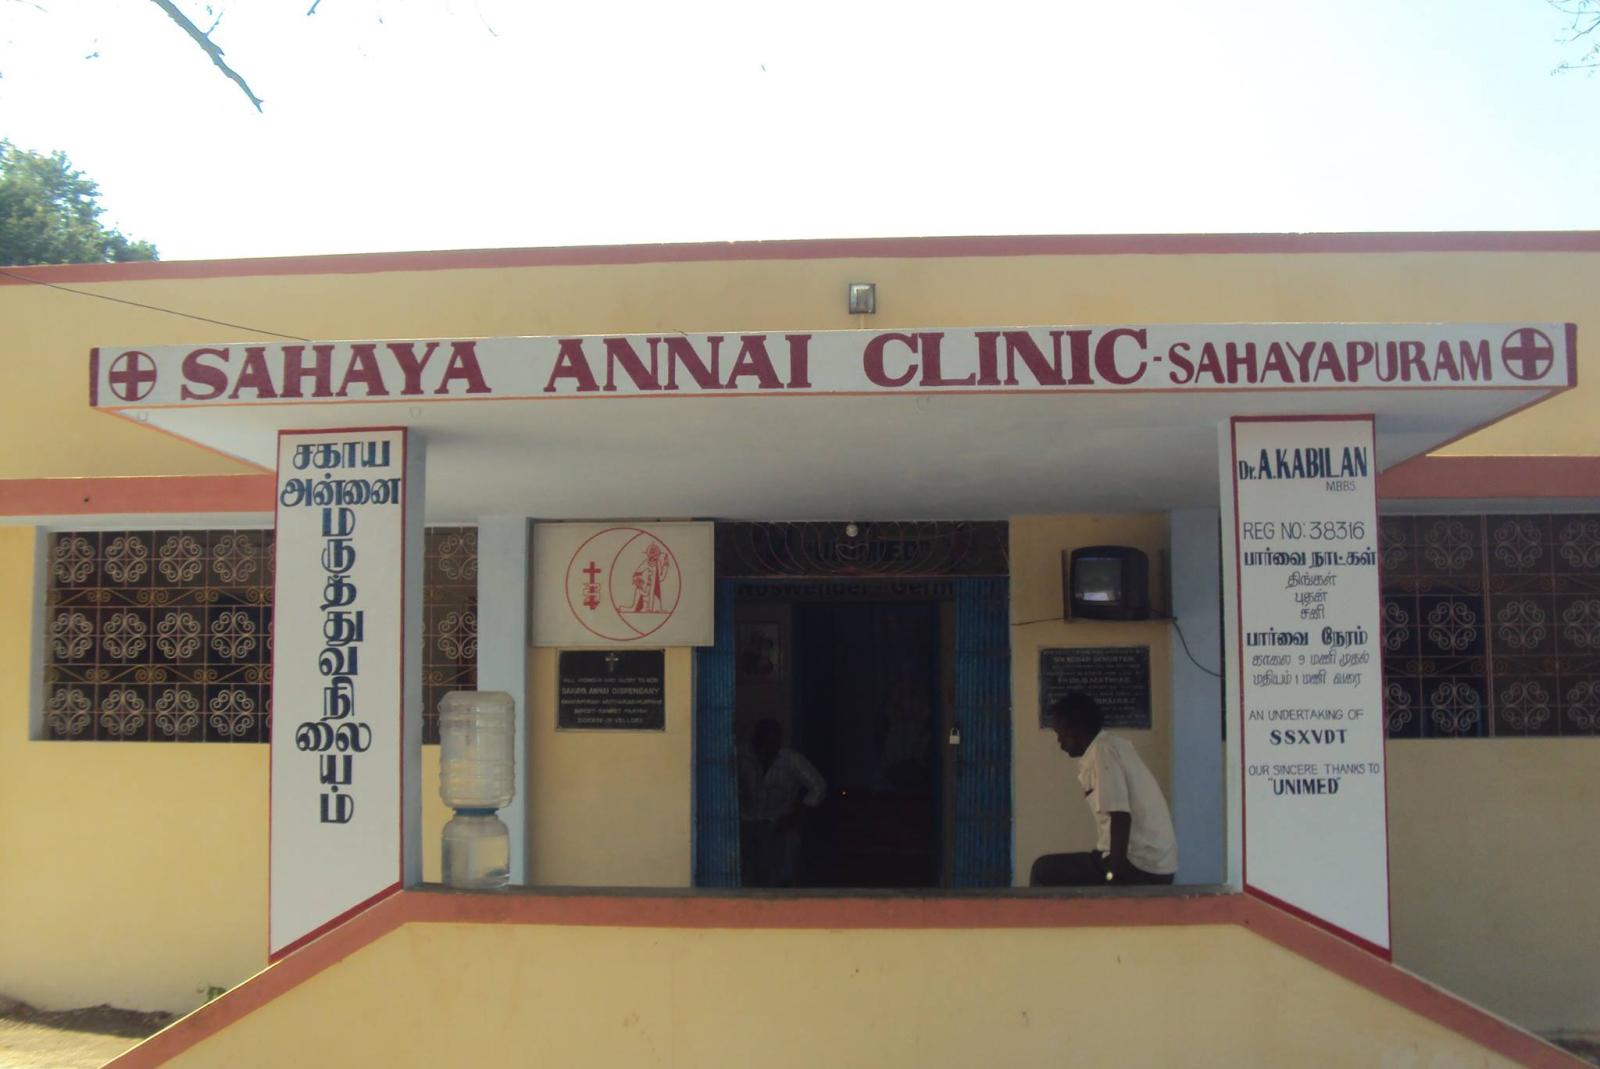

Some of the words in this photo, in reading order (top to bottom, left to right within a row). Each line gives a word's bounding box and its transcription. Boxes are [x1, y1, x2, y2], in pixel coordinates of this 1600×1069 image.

[181, 340, 492, 401] SAHAYA
[543, 333, 813, 394] ANNAI
[293, 440, 391, 470] சகாய
[280, 472, 401, 508] அன்னை
[1243, 521, 1275, 540] REG
[1309, 520, 1365, 541] 38316
[1244, 546, 1306, 567] பார்வை
[1309, 546, 1377, 569] நாட்கள்
[1285, 570, 1337, 590] திங்கள்
[1294, 588, 1329, 607] புதன்
[1300, 603, 1326, 621] சனி
[1246, 626, 1309, 647] பார்வை
[1321, 625, 1369, 649] நேரம்
[1249, 710, 1264, 721] AN
[1268, 709, 1344, 721] UNDERTAKING
[1347, 709, 1364, 720] OF
[1269, 729, 1348, 746] SSXVDT
[1248, 764, 1270, 777] OUR
[1273, 764, 1318, 776] SINCERE
[1325, 763, 1366, 775] THANKS
[1368, 763, 1380, 774] TO
